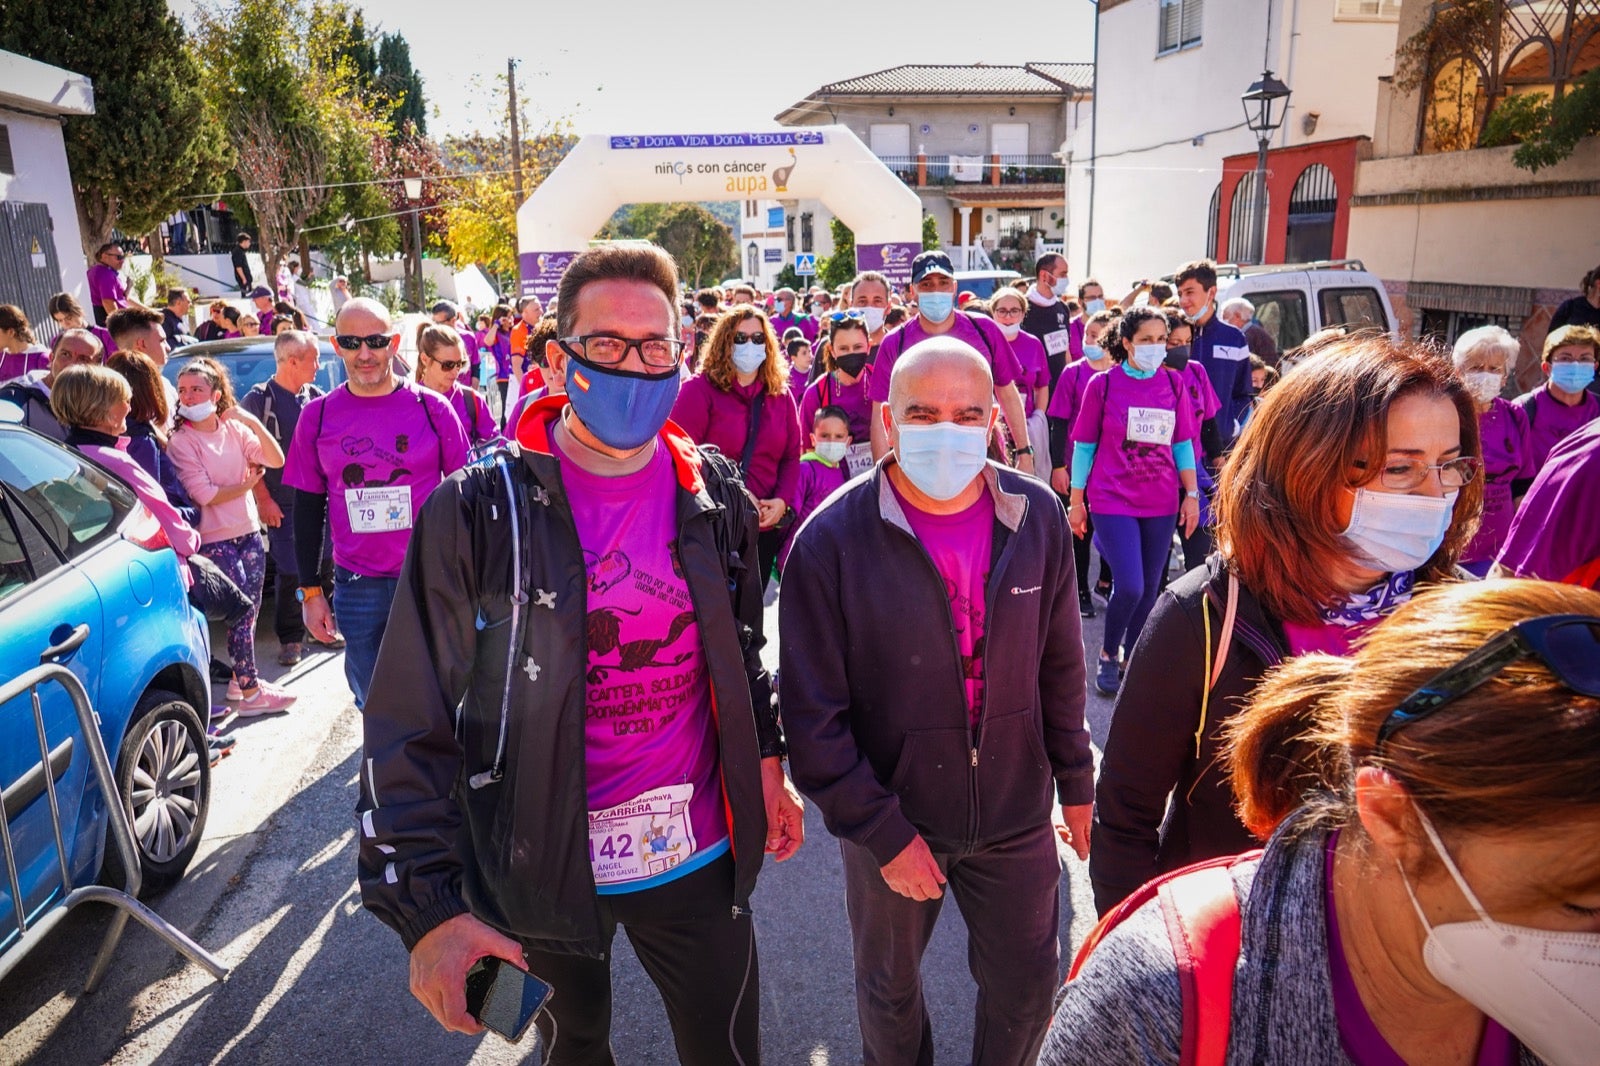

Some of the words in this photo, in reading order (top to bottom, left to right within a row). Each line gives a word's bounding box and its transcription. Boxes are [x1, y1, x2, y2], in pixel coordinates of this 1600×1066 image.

[697, 163, 720, 174] con
[723, 160, 767, 174] cáncer
[726, 175, 767, 196] aupa
[1135, 423, 1155, 434] 305
[850, 457, 872, 469] 1142
[356, 490, 364, 501] V
[359, 508, 375, 521] 79
[1011, 585, 1042, 595] Champion
[598, 861, 622, 872] ÁNGEL
